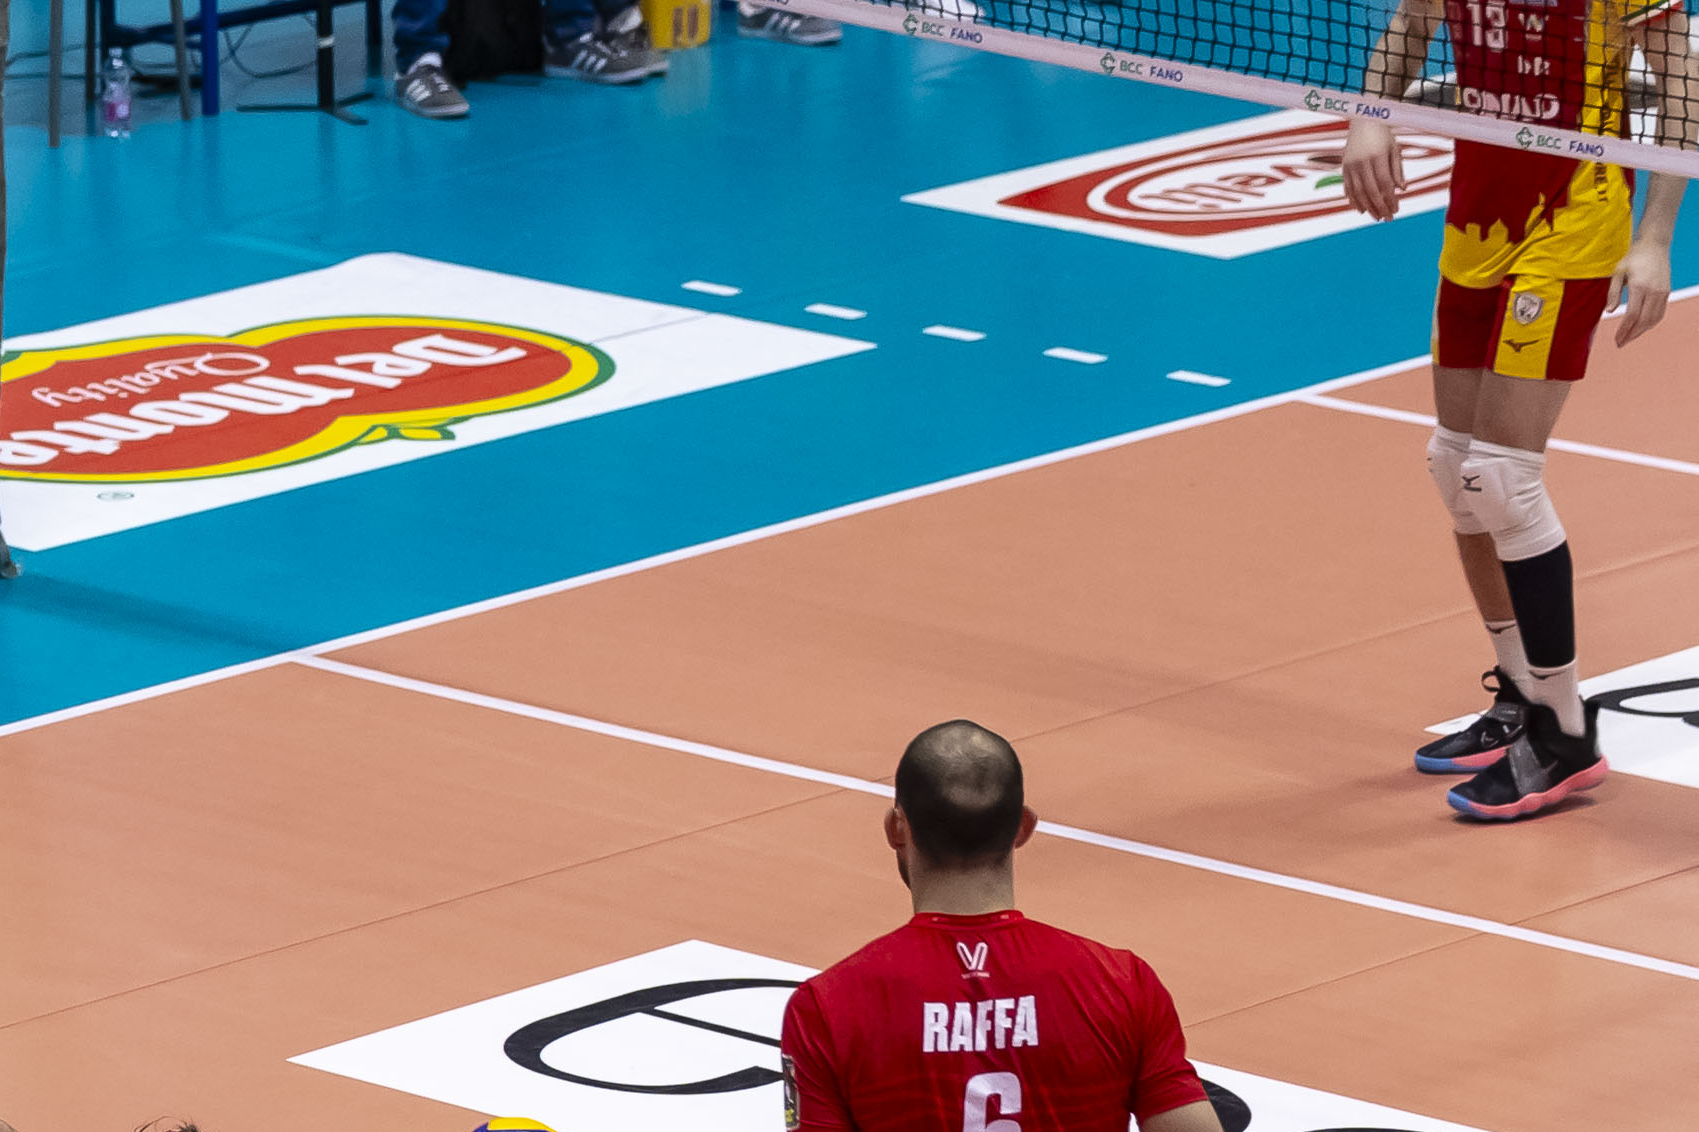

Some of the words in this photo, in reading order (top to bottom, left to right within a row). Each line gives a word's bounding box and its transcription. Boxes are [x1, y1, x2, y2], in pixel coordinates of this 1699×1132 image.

[921, 21, 944, 38] BCC
[950, 27, 984, 45] FANO
[1119, 59, 1144, 76] BCC
[1149, 65, 1185, 83] FANO
[1323, 97, 1349, 114] BCC
[1355, 102, 1391, 121] FANO
[1535, 134, 1562, 151] BCC
[1568, 139, 1605, 158] FANO
[292, 333, 528, 391] Del
[31, 351, 271, 408] Quality
[921, 994, 1040, 1054] RAFFA
